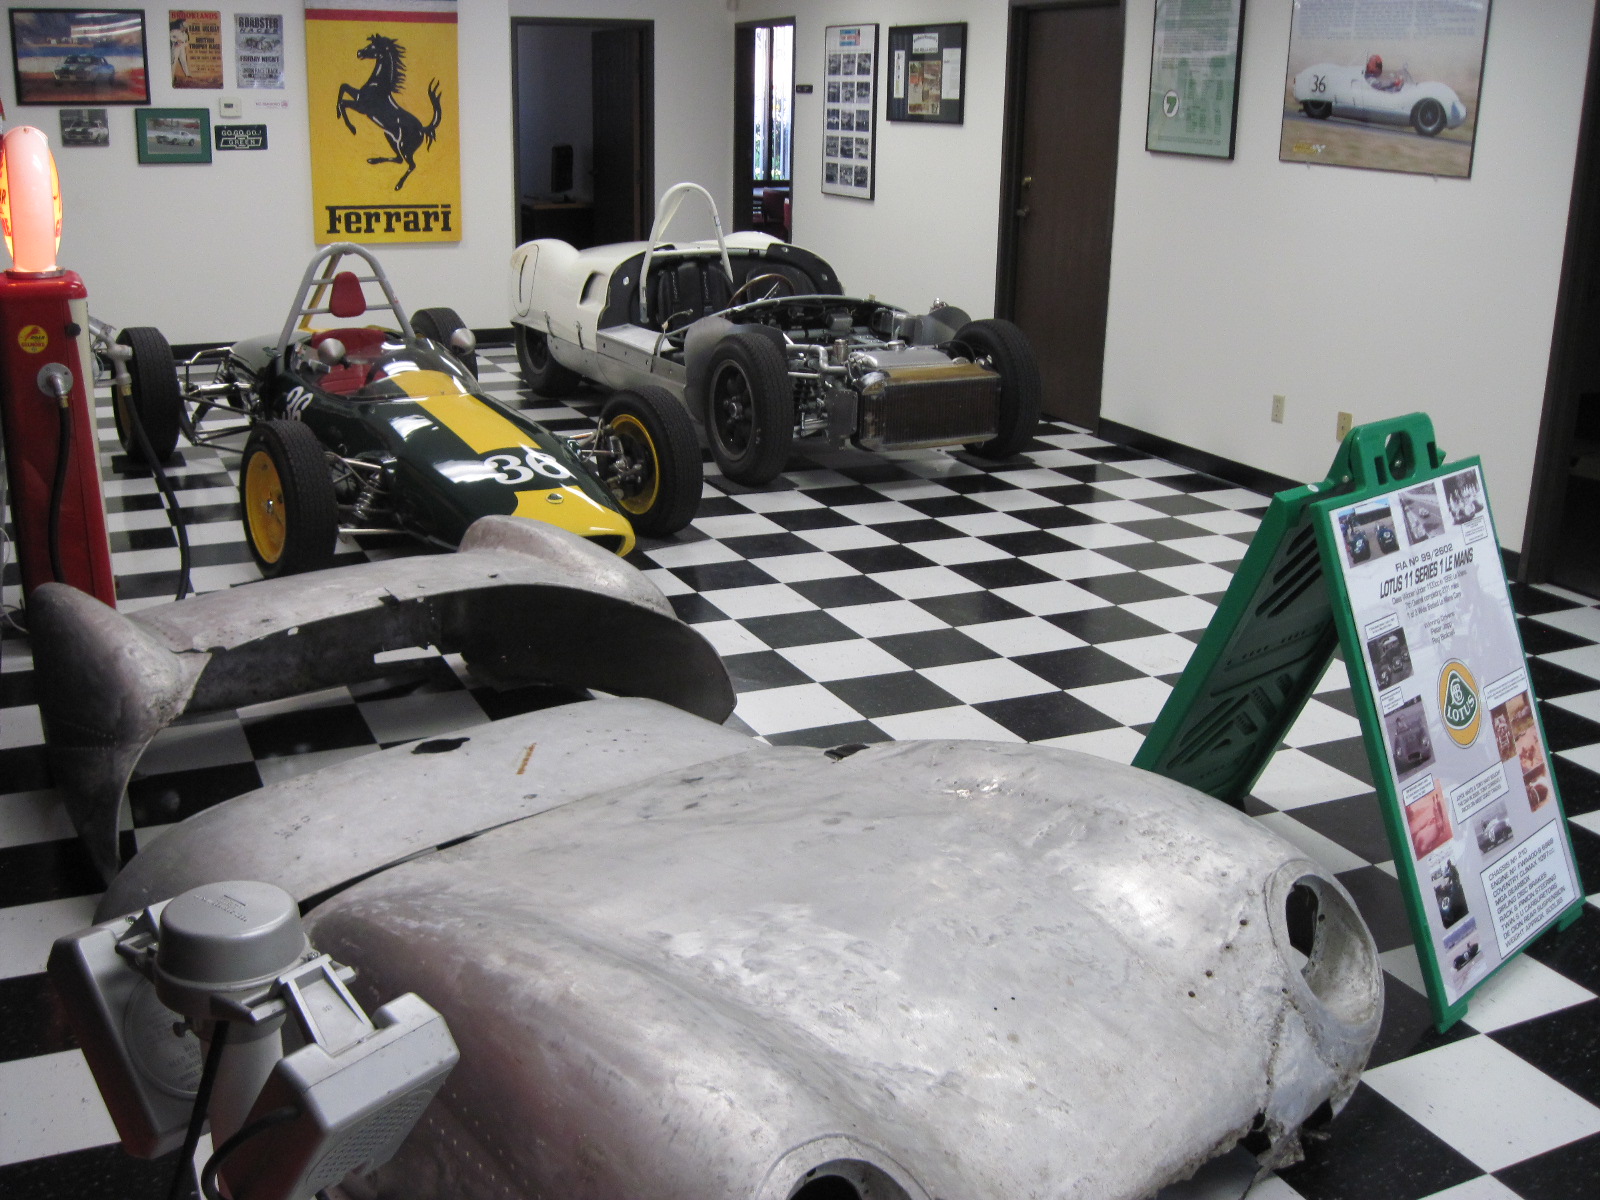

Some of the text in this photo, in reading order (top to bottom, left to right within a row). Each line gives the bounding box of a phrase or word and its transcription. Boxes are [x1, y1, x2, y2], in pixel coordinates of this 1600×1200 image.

[238, 16, 278, 28] ROADSTER
[1311, 74, 1326, 93] 36
[1166, 95, 1177, 114] 7
[325, 204, 452, 234] Ferrari
[484, 452, 572, 484] 36
[1380, 547, 1473, 599] LOTUS 11 SERIES 1 LE MANS
[1395, 561, 1408, 572] FIA
[1447, 695, 1475, 721] LOTUS
[1488, 861, 1510, 881] CHASSIS
[1518, 848, 1528, 858] 210
[1493, 874, 1518, 898] COVENTRY
[1519, 860, 1537, 877] CLIMAX
[1490, 872, 1509, 890] ENGINE
[1495, 875, 1530, 906] MGA GEARBOX
[1497, 872, 1546, 914] GIRLING DISC BRAKES
[1499, 908, 1513, 922] RACK
[1518, 892, 1535, 907] PINION
[1535, 874, 1556, 894] STEERING
[1501, 916, 1516, 930] TWIN
[1524, 882, 1558, 912] CARBURETORS
[1503, 886, 1566, 939] DE DION REAR SUSPENSION
[1505, 928, 1524, 948] WEIGHT
